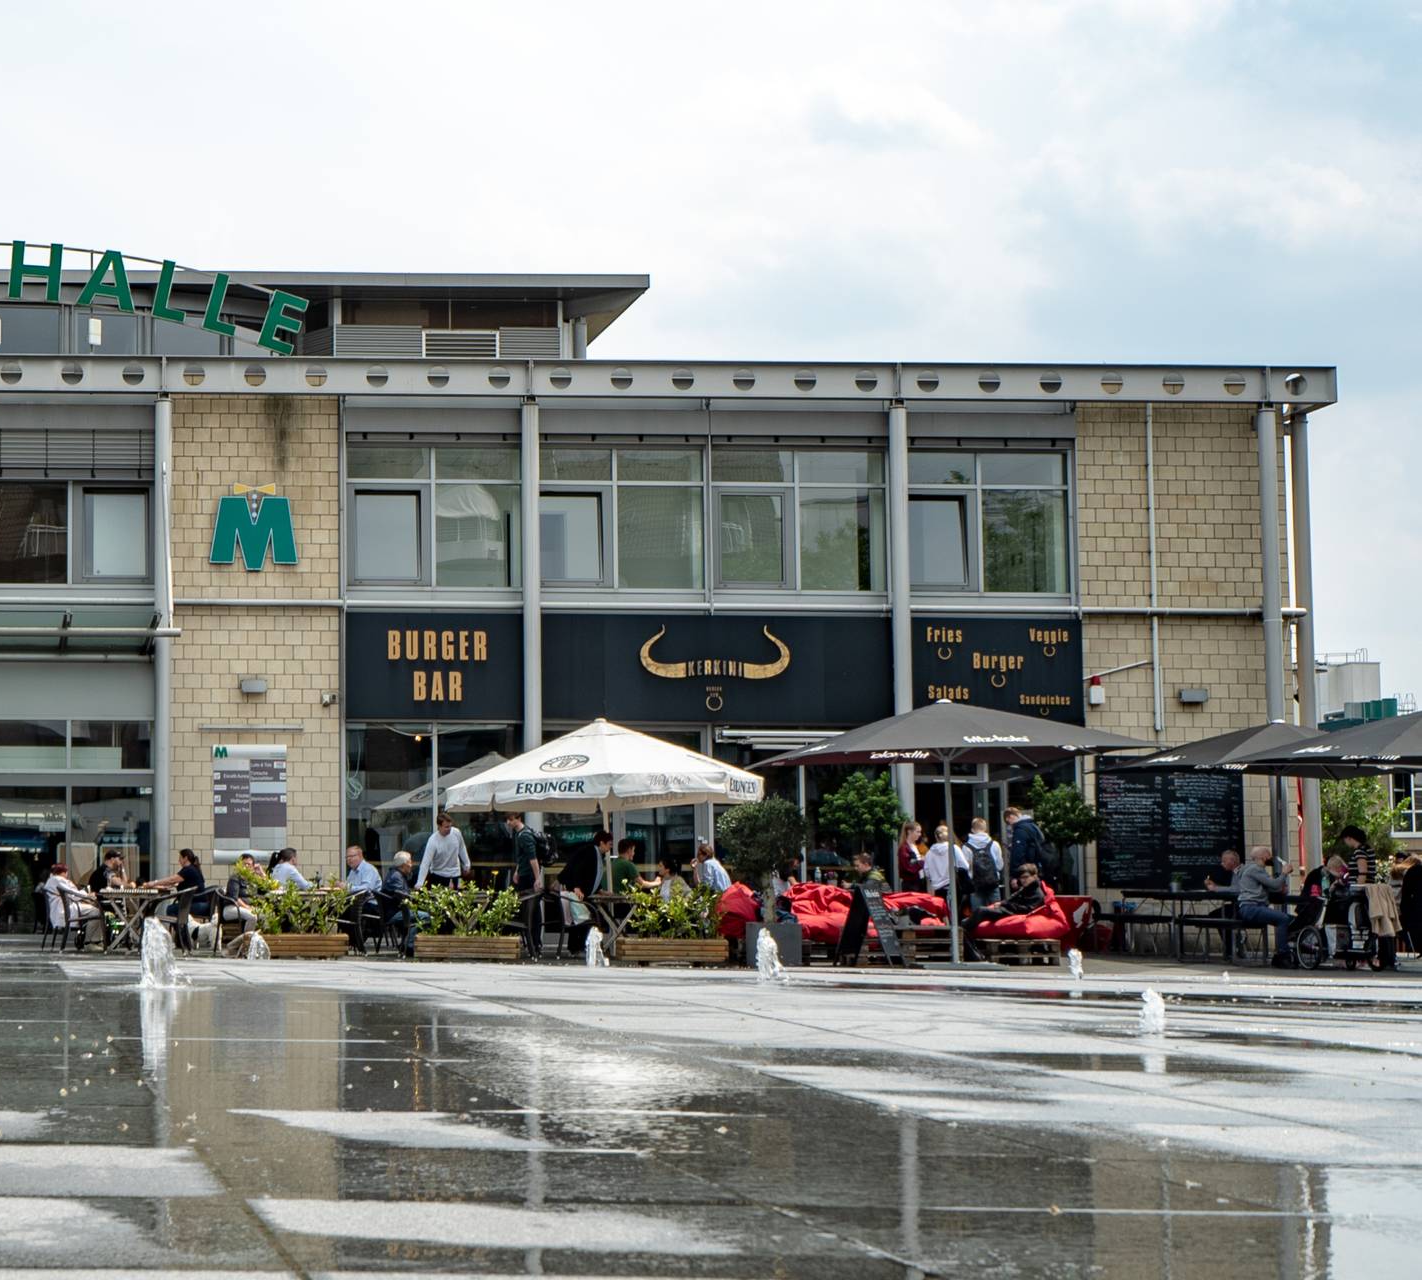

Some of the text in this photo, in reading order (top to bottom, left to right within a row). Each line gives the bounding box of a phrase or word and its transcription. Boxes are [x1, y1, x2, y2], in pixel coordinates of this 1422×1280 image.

[209, 495, 298, 571] M
[926, 627, 963, 643] Fries
[1029, 628, 1069, 644] Veggie
[387, 630, 487, 661] BURGER
[687, 659, 743, 677] KERKINI
[972, 653, 1024, 672] Burger
[413, 671, 462, 701] BAR
[928, 684, 969, 700] Salads
[1020, 694, 1071, 705] Sandwiches
[515, 780, 585, 795] ERDINGER
